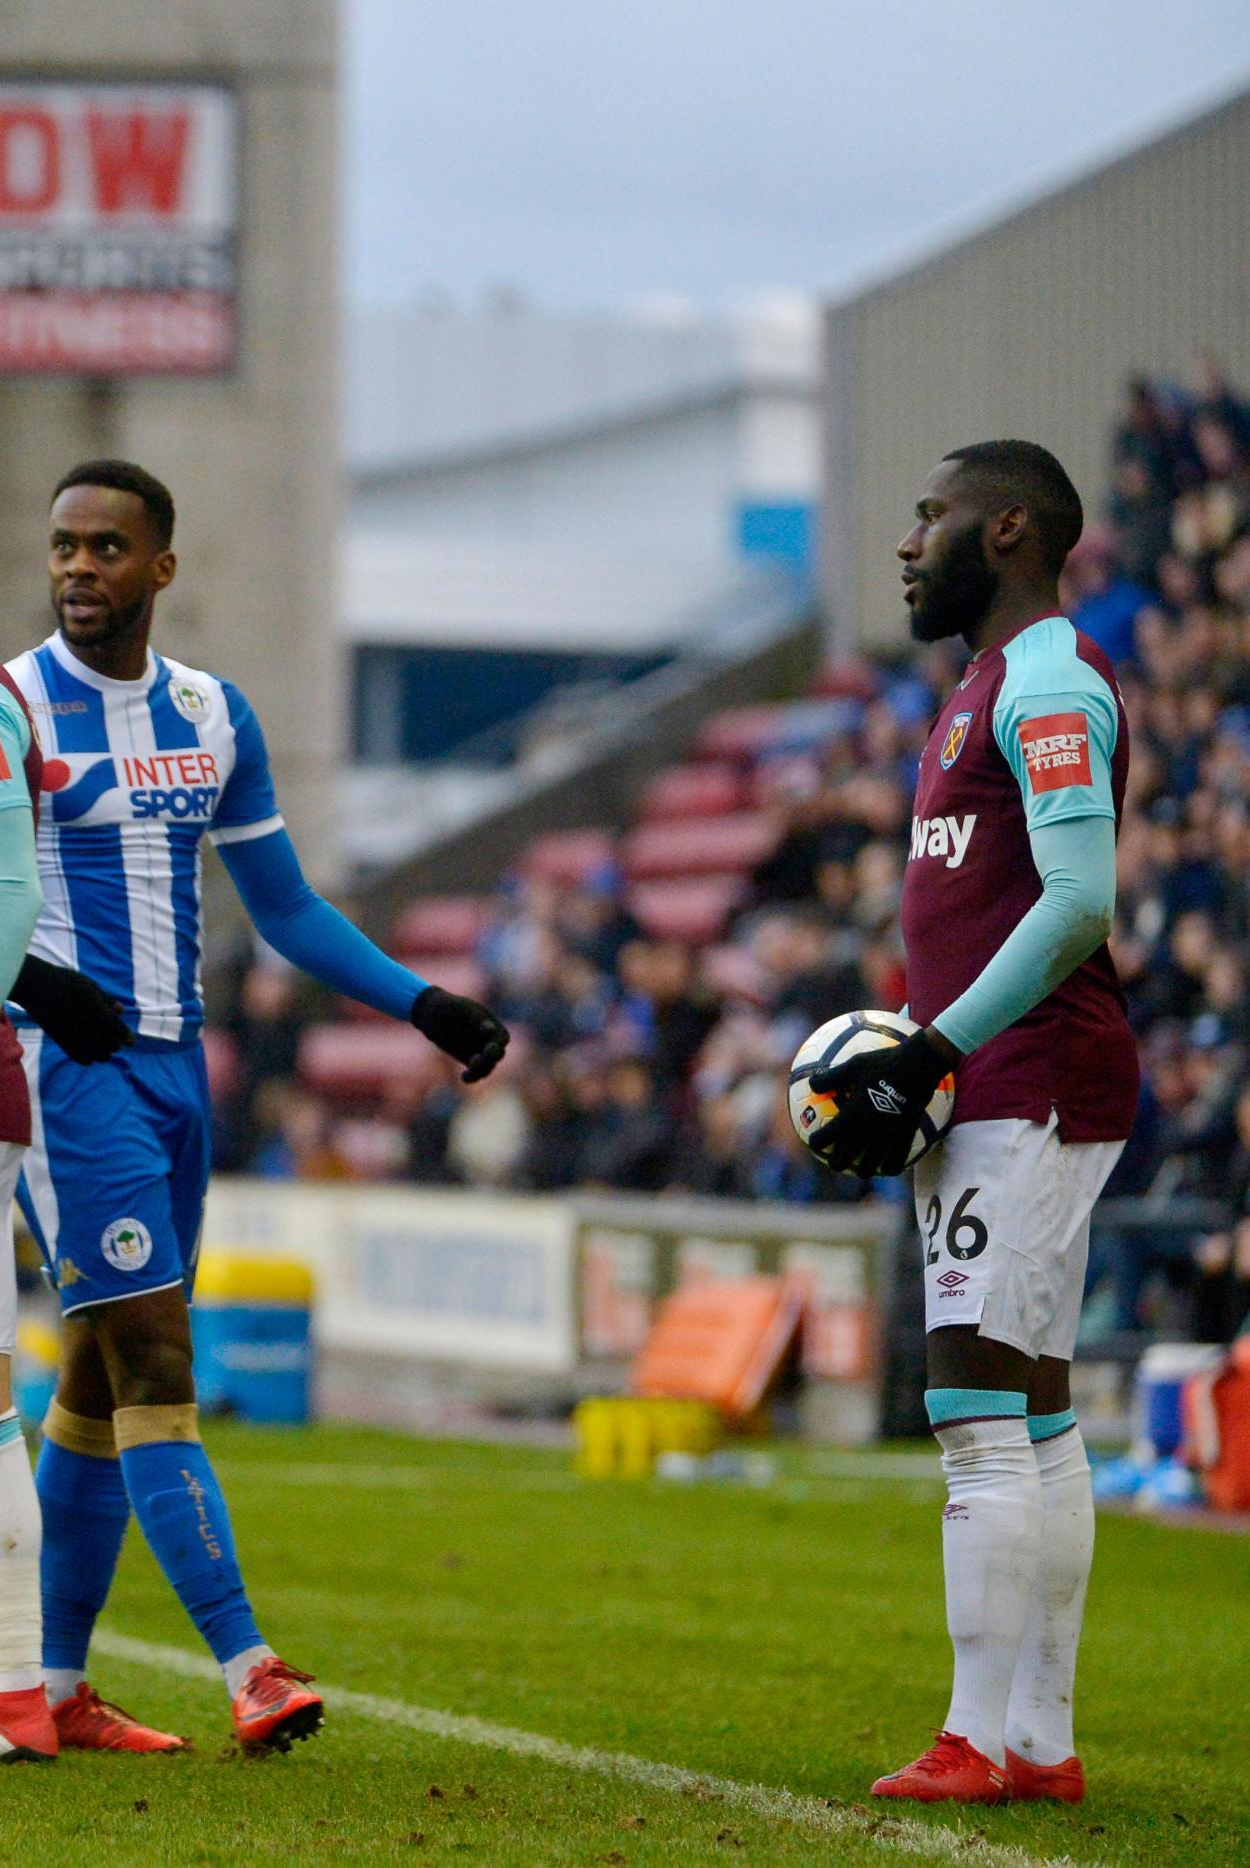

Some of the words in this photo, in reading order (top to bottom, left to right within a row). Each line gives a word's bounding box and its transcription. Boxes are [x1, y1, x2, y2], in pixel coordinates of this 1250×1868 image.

[1023, 733, 1087, 760] MRF
[1031, 751, 1082, 772] TYRES
[123, 753, 219, 787] INTER
[130, 786, 220, 818] SPORT
[907, 815, 978, 868] way
[924, 1187, 989, 1266] 26
[939, 1289, 966, 1299] umbro
